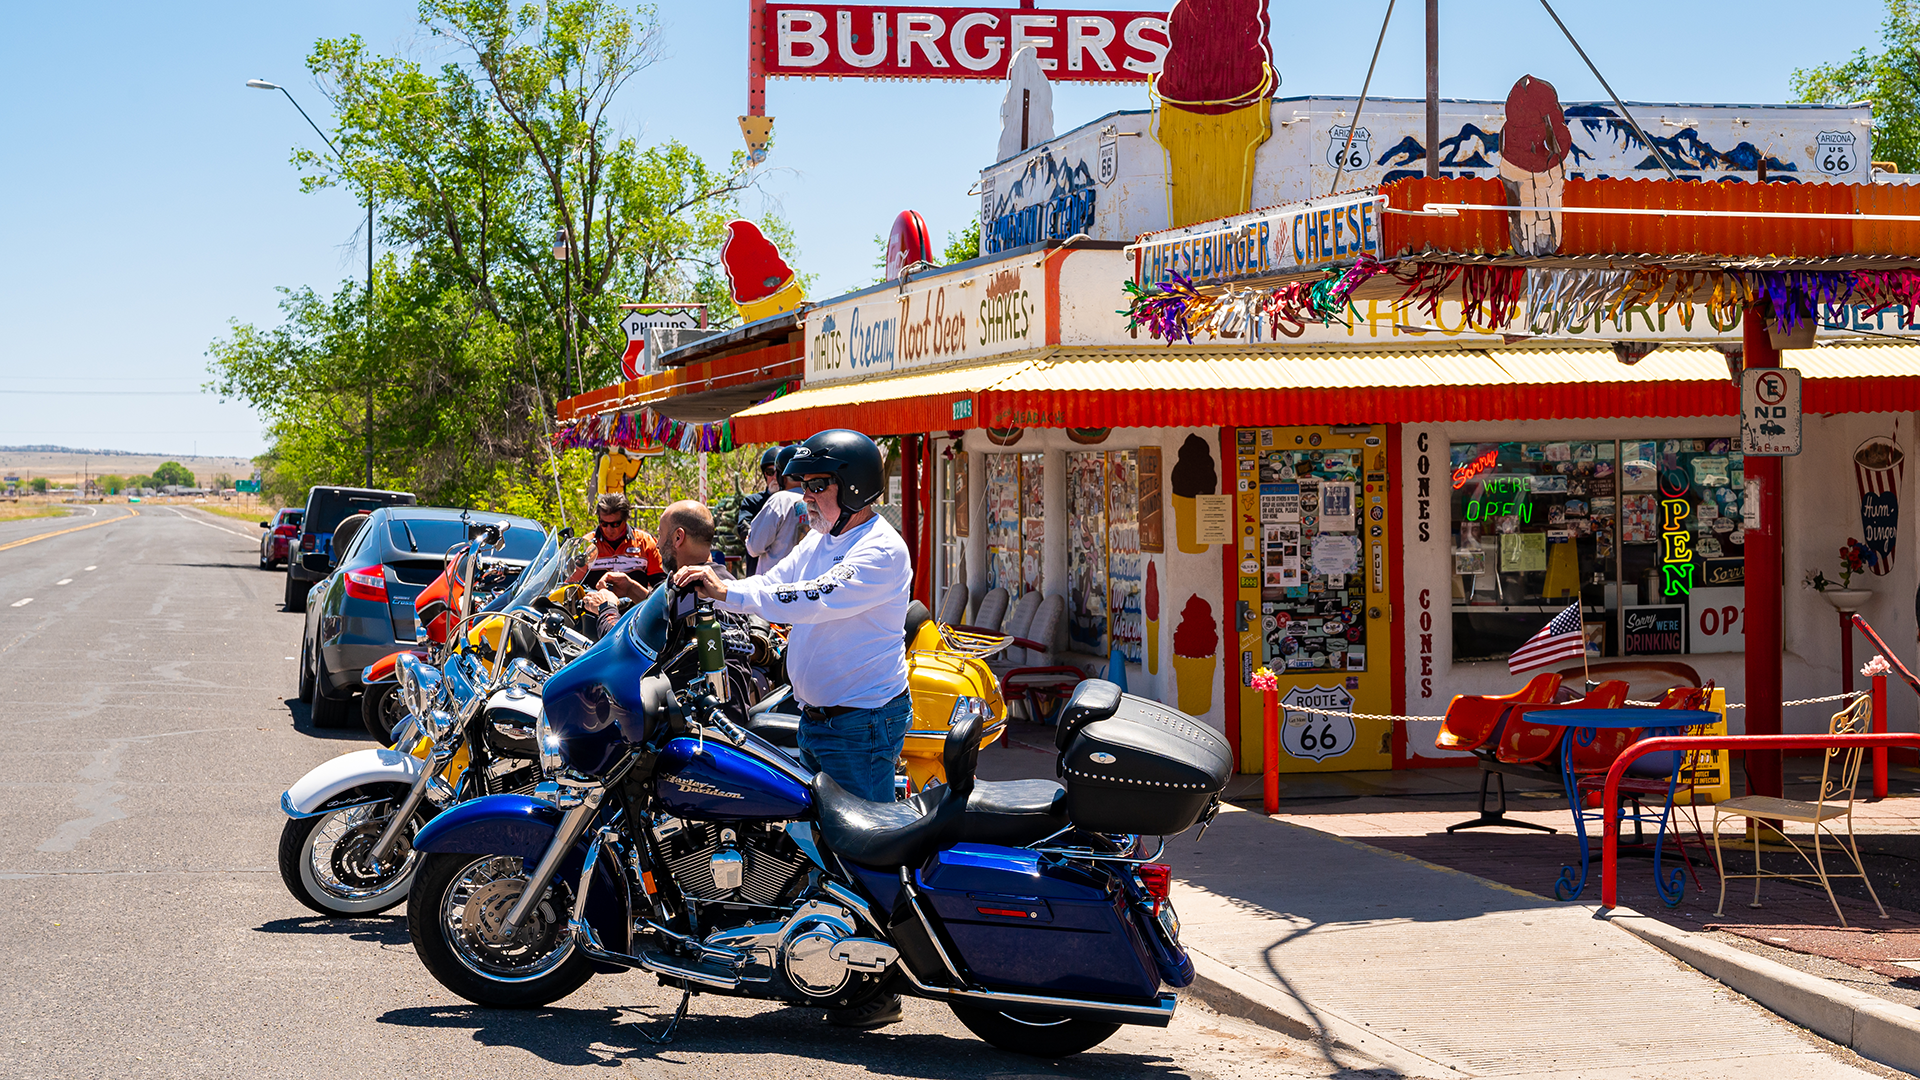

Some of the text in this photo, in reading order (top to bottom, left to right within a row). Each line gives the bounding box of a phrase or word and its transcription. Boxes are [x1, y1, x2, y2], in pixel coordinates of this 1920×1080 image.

[777, 9, 1169, 74] BURGERS
[1334, 129, 1366, 139] ARIZNA
[1820, 134, 1852, 143] ARIZONA
[1101, 157, 1112, 178] 66
[1335, 150, 1363, 168] 66
[1823, 154, 1850, 171] 66
[1141, 220, 1270, 287] CHEESEBURGER
[1292, 201, 1377, 266] CHEESE
[814, 286, 1030, 372] MALTS Creamy Root Beer SHAKES
[1767, 380, 1778, 395] E
[1755, 406, 1787, 419] NO
[1452, 450, 1499, 490] Sorry
[1417, 432, 1431, 542] CONES
[1482, 476, 1532, 494] WE'RE
[1466, 500, 1533, 524] OPEN
[1659, 466, 1695, 596] OPEN
[1709, 566, 1744, 583] Sorr
[1626, 613, 1679, 632] Sorry WE'RE
[1700, 605, 1745, 636] OP
[1419, 588, 1432, 698] CONES
[1626, 632, 1680, 652] DRINKING
[1297, 694, 1338, 708] ROUTE
[1300, 723, 1337, 751] 66
[678, 784, 745, 799] Davidson
